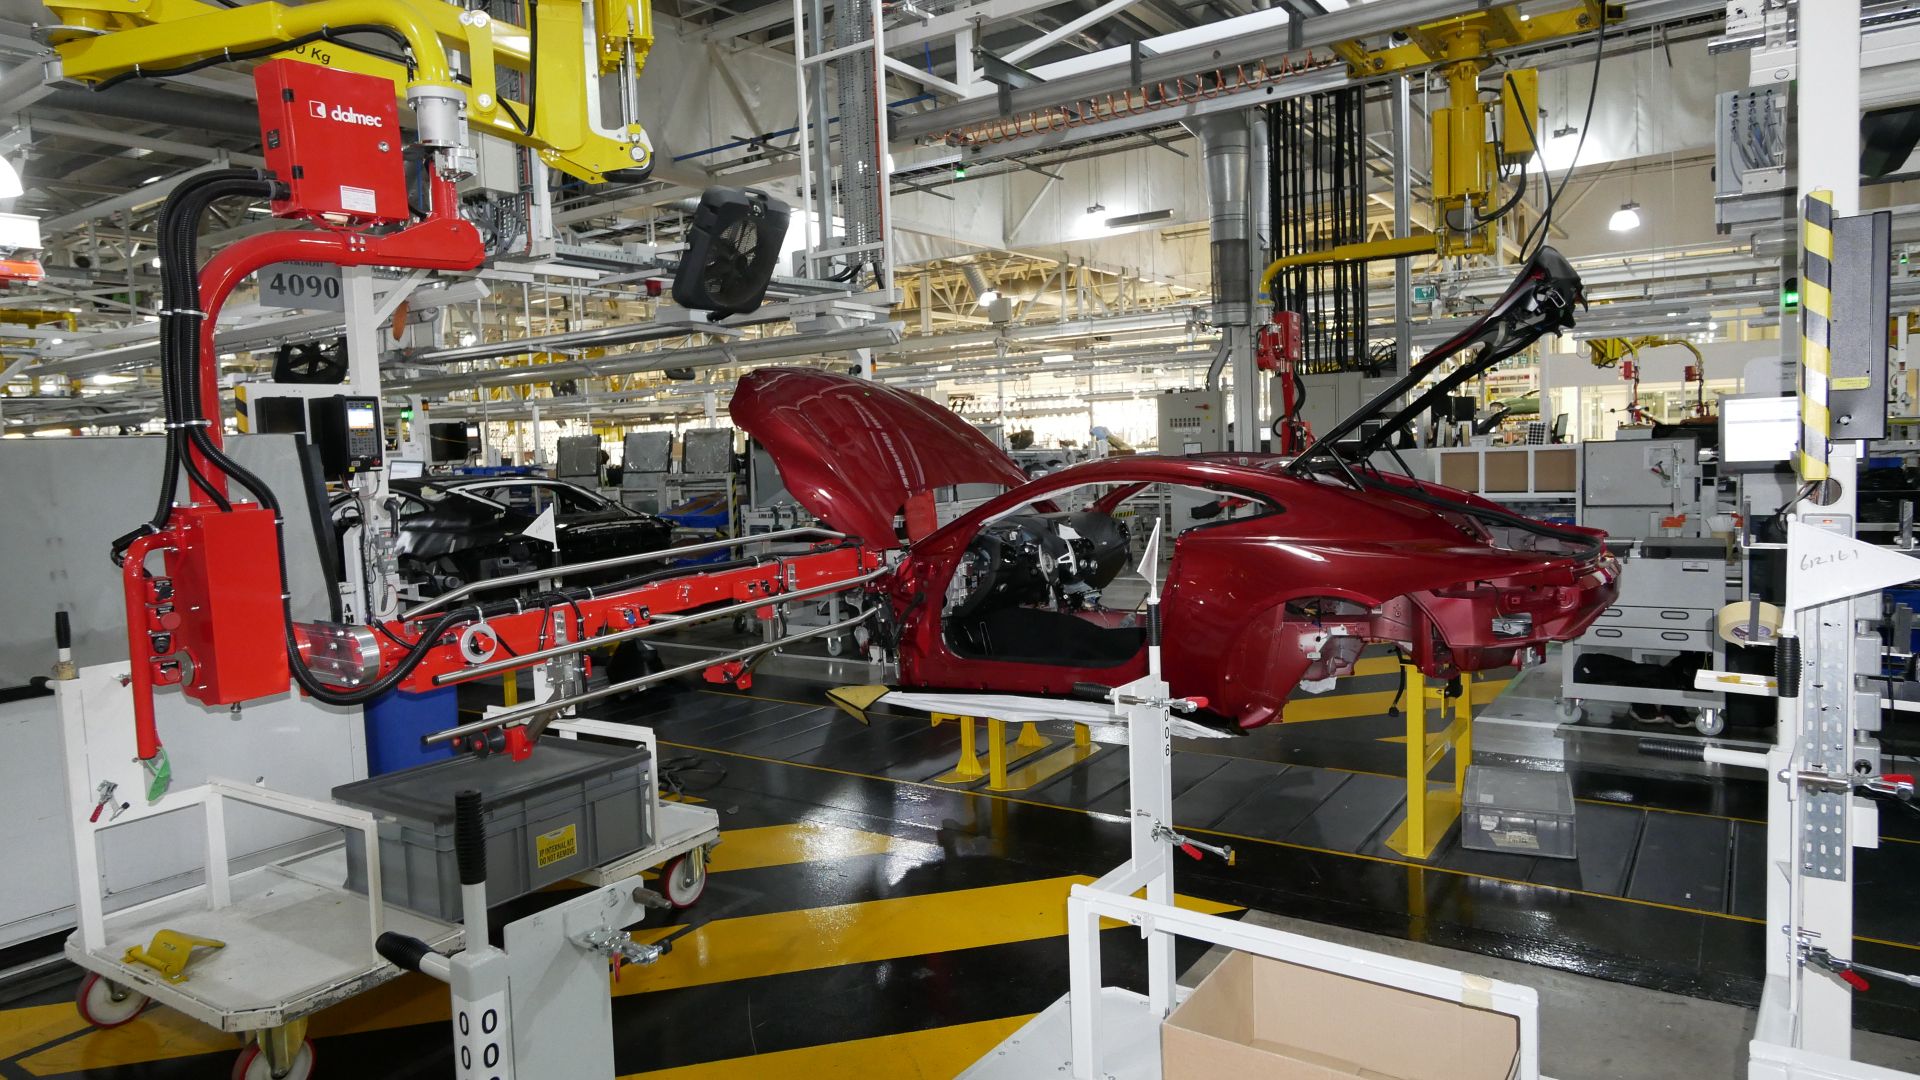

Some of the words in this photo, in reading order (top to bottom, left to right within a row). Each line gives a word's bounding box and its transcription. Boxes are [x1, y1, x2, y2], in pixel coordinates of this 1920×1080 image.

[311, 47, 331, 65] Kg
[331, 104, 383, 128] dalmec
[269, 272, 340, 299] 4090
[539, 856, 547, 866] DO
[547, 853, 556, 864] NOT
